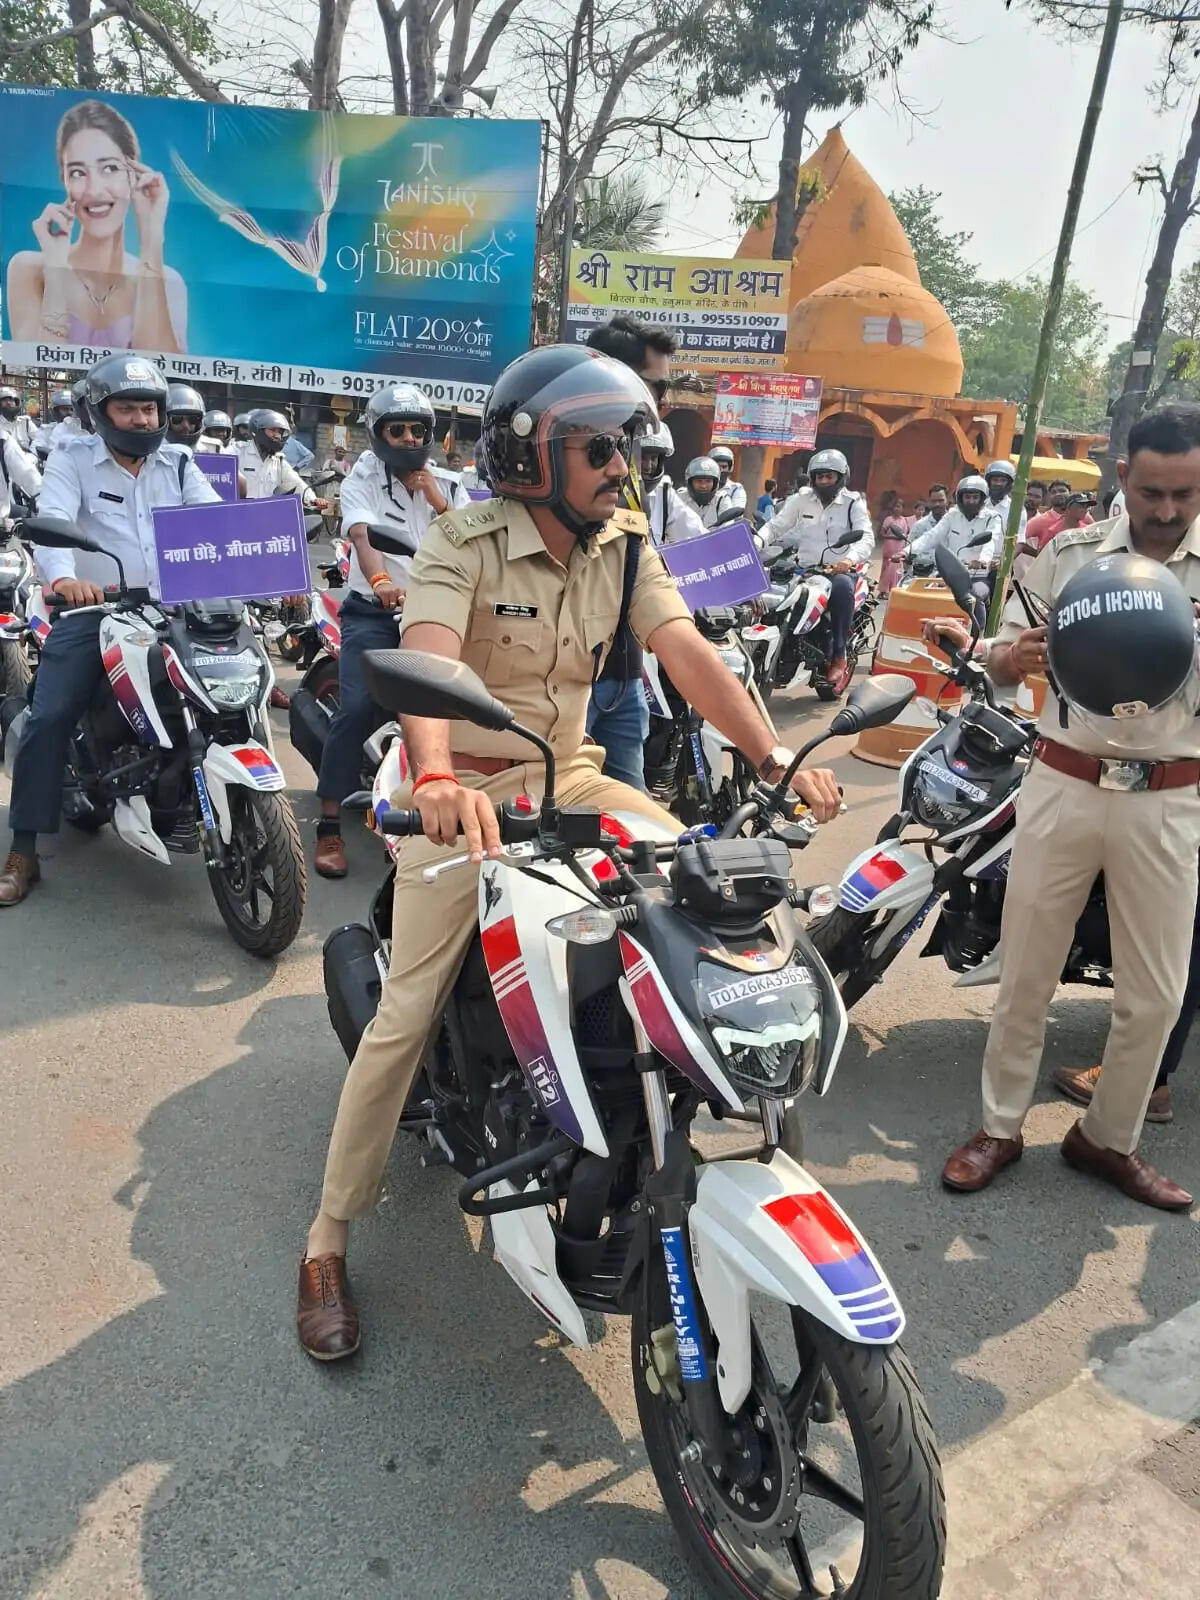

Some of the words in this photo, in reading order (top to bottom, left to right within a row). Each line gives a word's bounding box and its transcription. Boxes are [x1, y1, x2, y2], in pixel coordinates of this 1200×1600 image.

[26, 88, 55, 97] PRODUCT
[373, 222, 469, 254] Festival
[336, 242, 370, 284] Of
[375, 249, 501, 284] Diamonds
[576, 252, 612, 289] श्री
[624, 263, 676, 293] राम
[689, 267, 785, 298] आश्रम
[355, 311, 413, 339] FLAT
[569, 304, 591, 316] संपर्क
[701, 313, 780, 326] 9955510907
[364, 338, 394, 347] diamond
[396, 341, 414, 349] value
[415, 342, 436, 351] across
[687, 332, 703, 345] का
[704, 334, 731, 347] उत्तम
[733, 332, 760, 350] प्रबंध
[36, 345, 75, 364] स्प्रिंग
[251, 365, 282, 385] रांची
[342, 376, 486, 404] 9031001/02
[163, 548, 191, 563] नशा
[225, 539, 262, 557] जीवन
[710, 565, 726, 577] जान
[1058, 595, 1101, 630] POLICE
[1105, 590, 1164, 613] RANCHI
[133, 711, 145, 729] 112
[532, 1062, 556, 1102] 112
[485, 1124, 497, 1149] TVS
[666, 1263, 692, 1337] TRINITY
